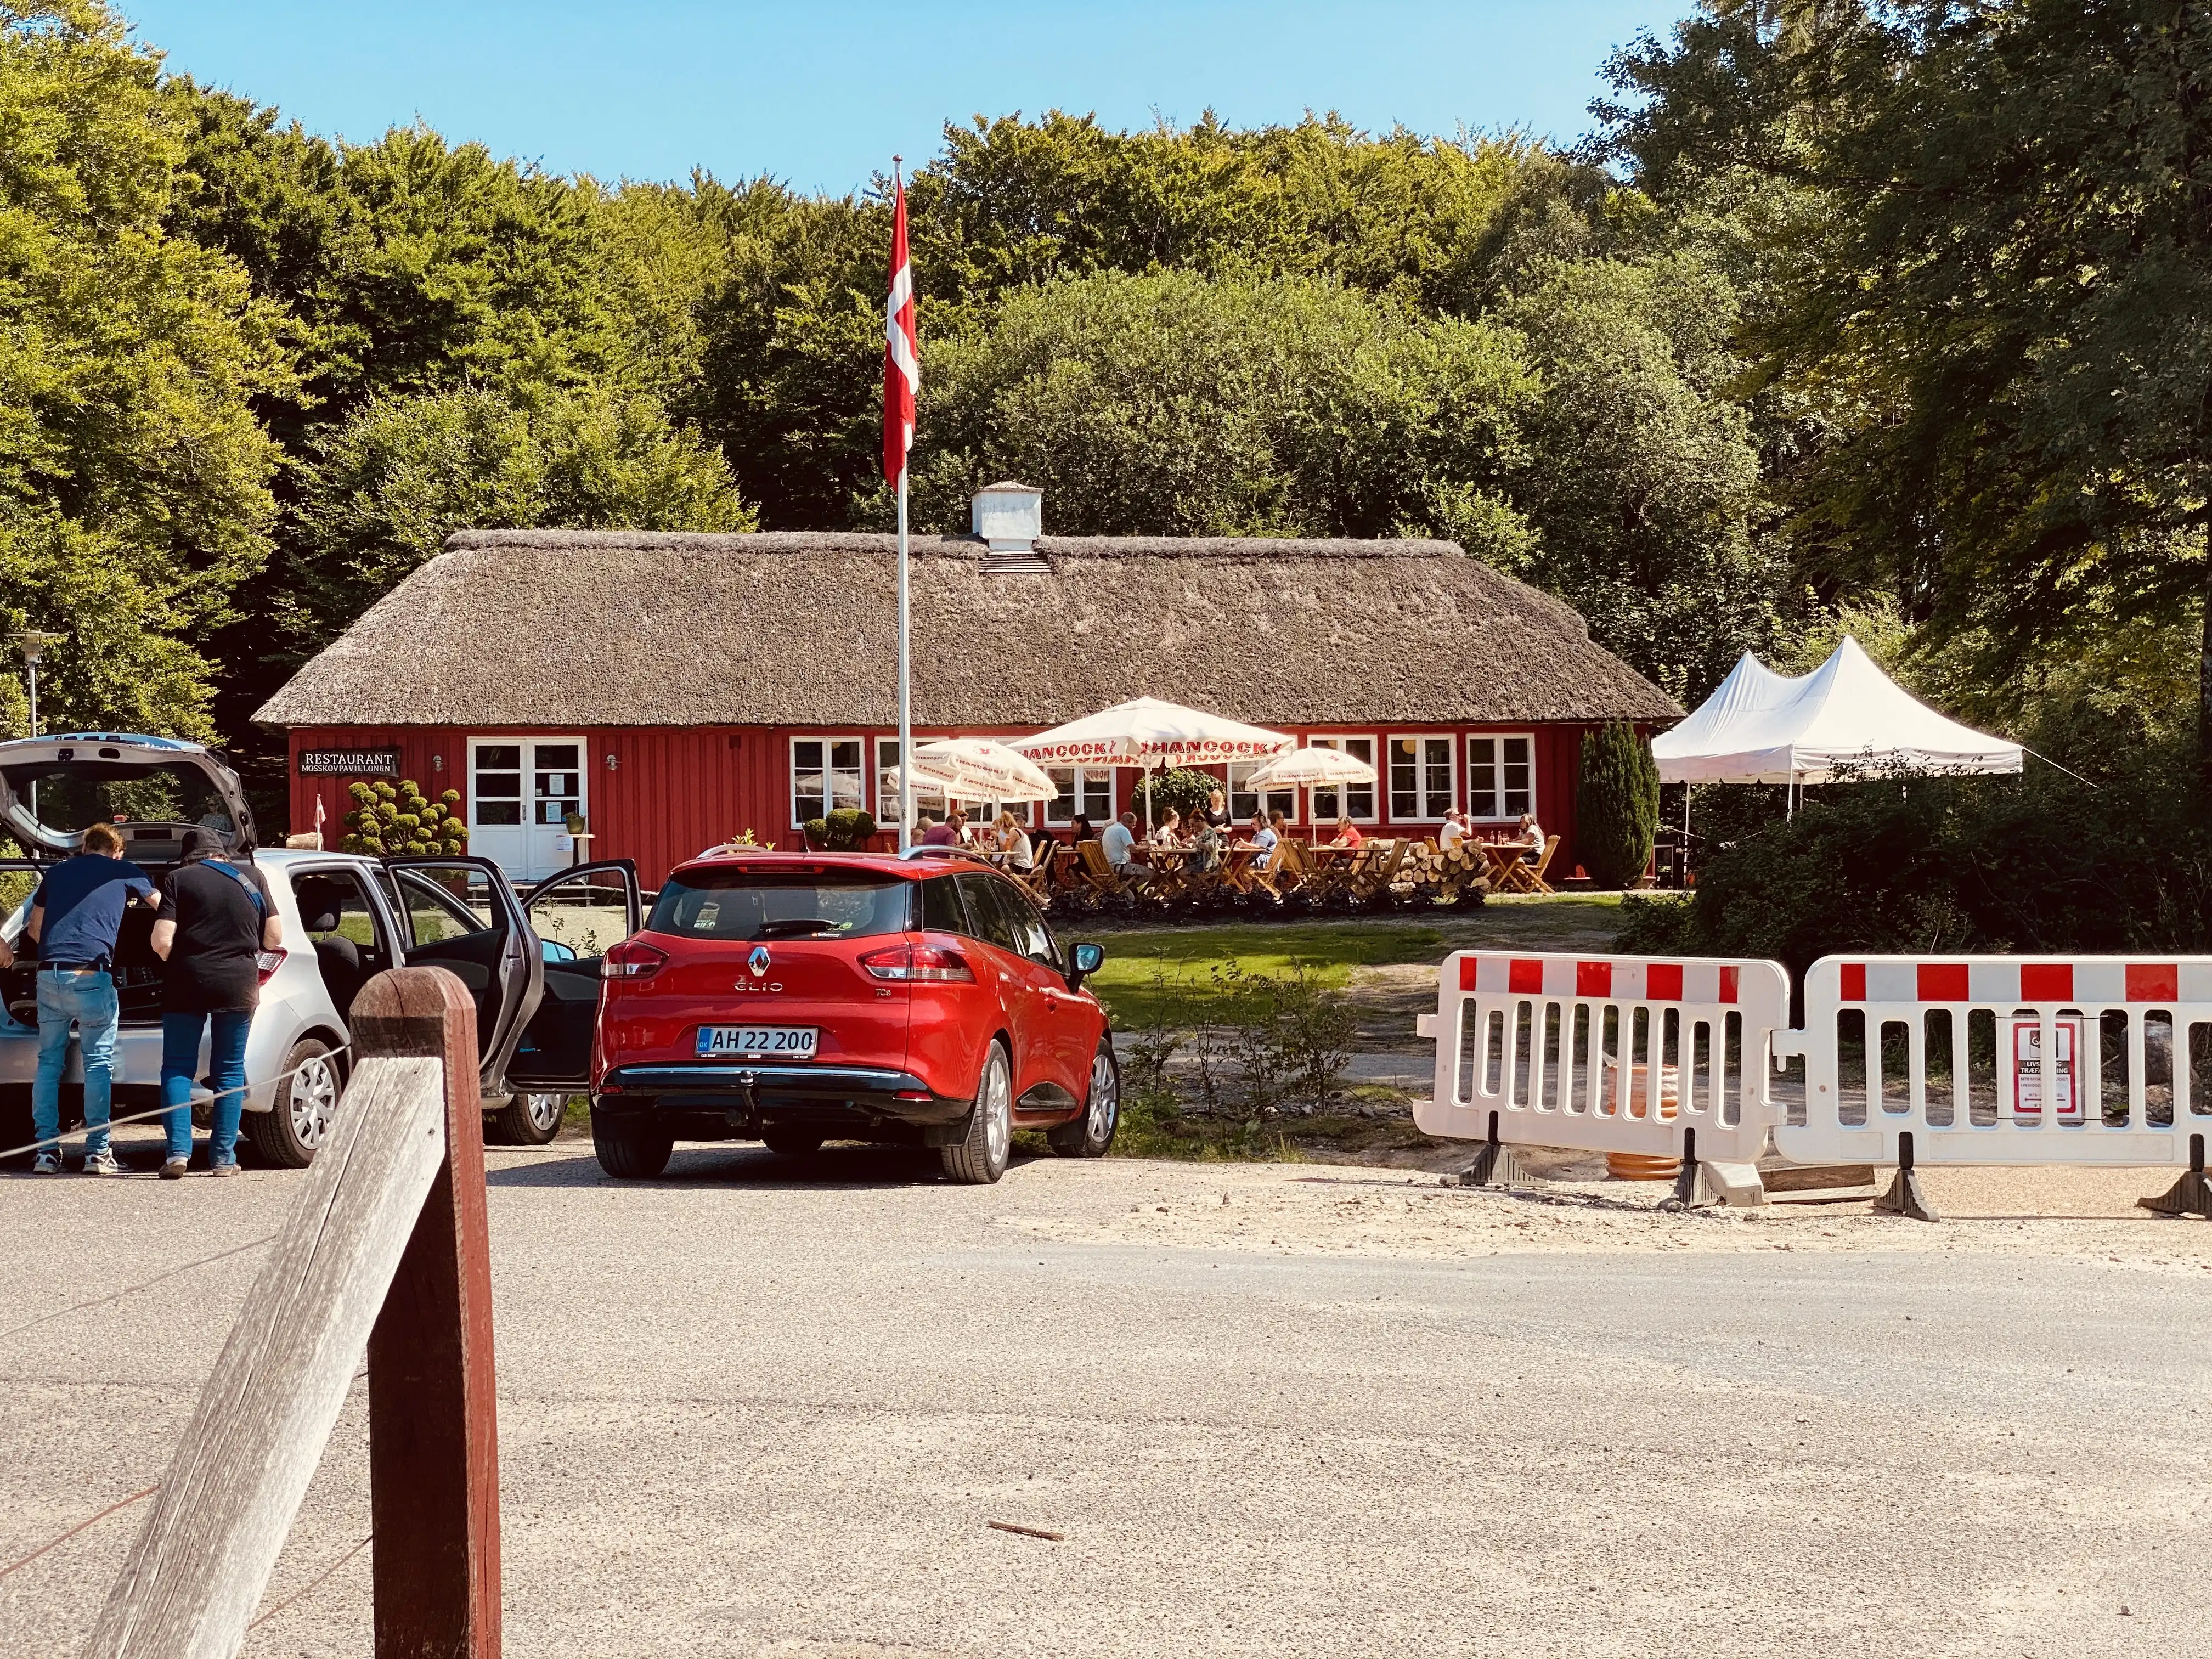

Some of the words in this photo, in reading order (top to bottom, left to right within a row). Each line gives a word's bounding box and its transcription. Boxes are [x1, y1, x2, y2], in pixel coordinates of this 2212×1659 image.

[1152, 741, 1268, 754] HANCOCK
[306, 753, 393, 765] RESTAURANT
[735, 983, 783, 991] CLIO
[712, 1031, 740, 1049] AH
[744, 1031, 769, 1049] 22
[775, 1032, 813, 1050] 200
